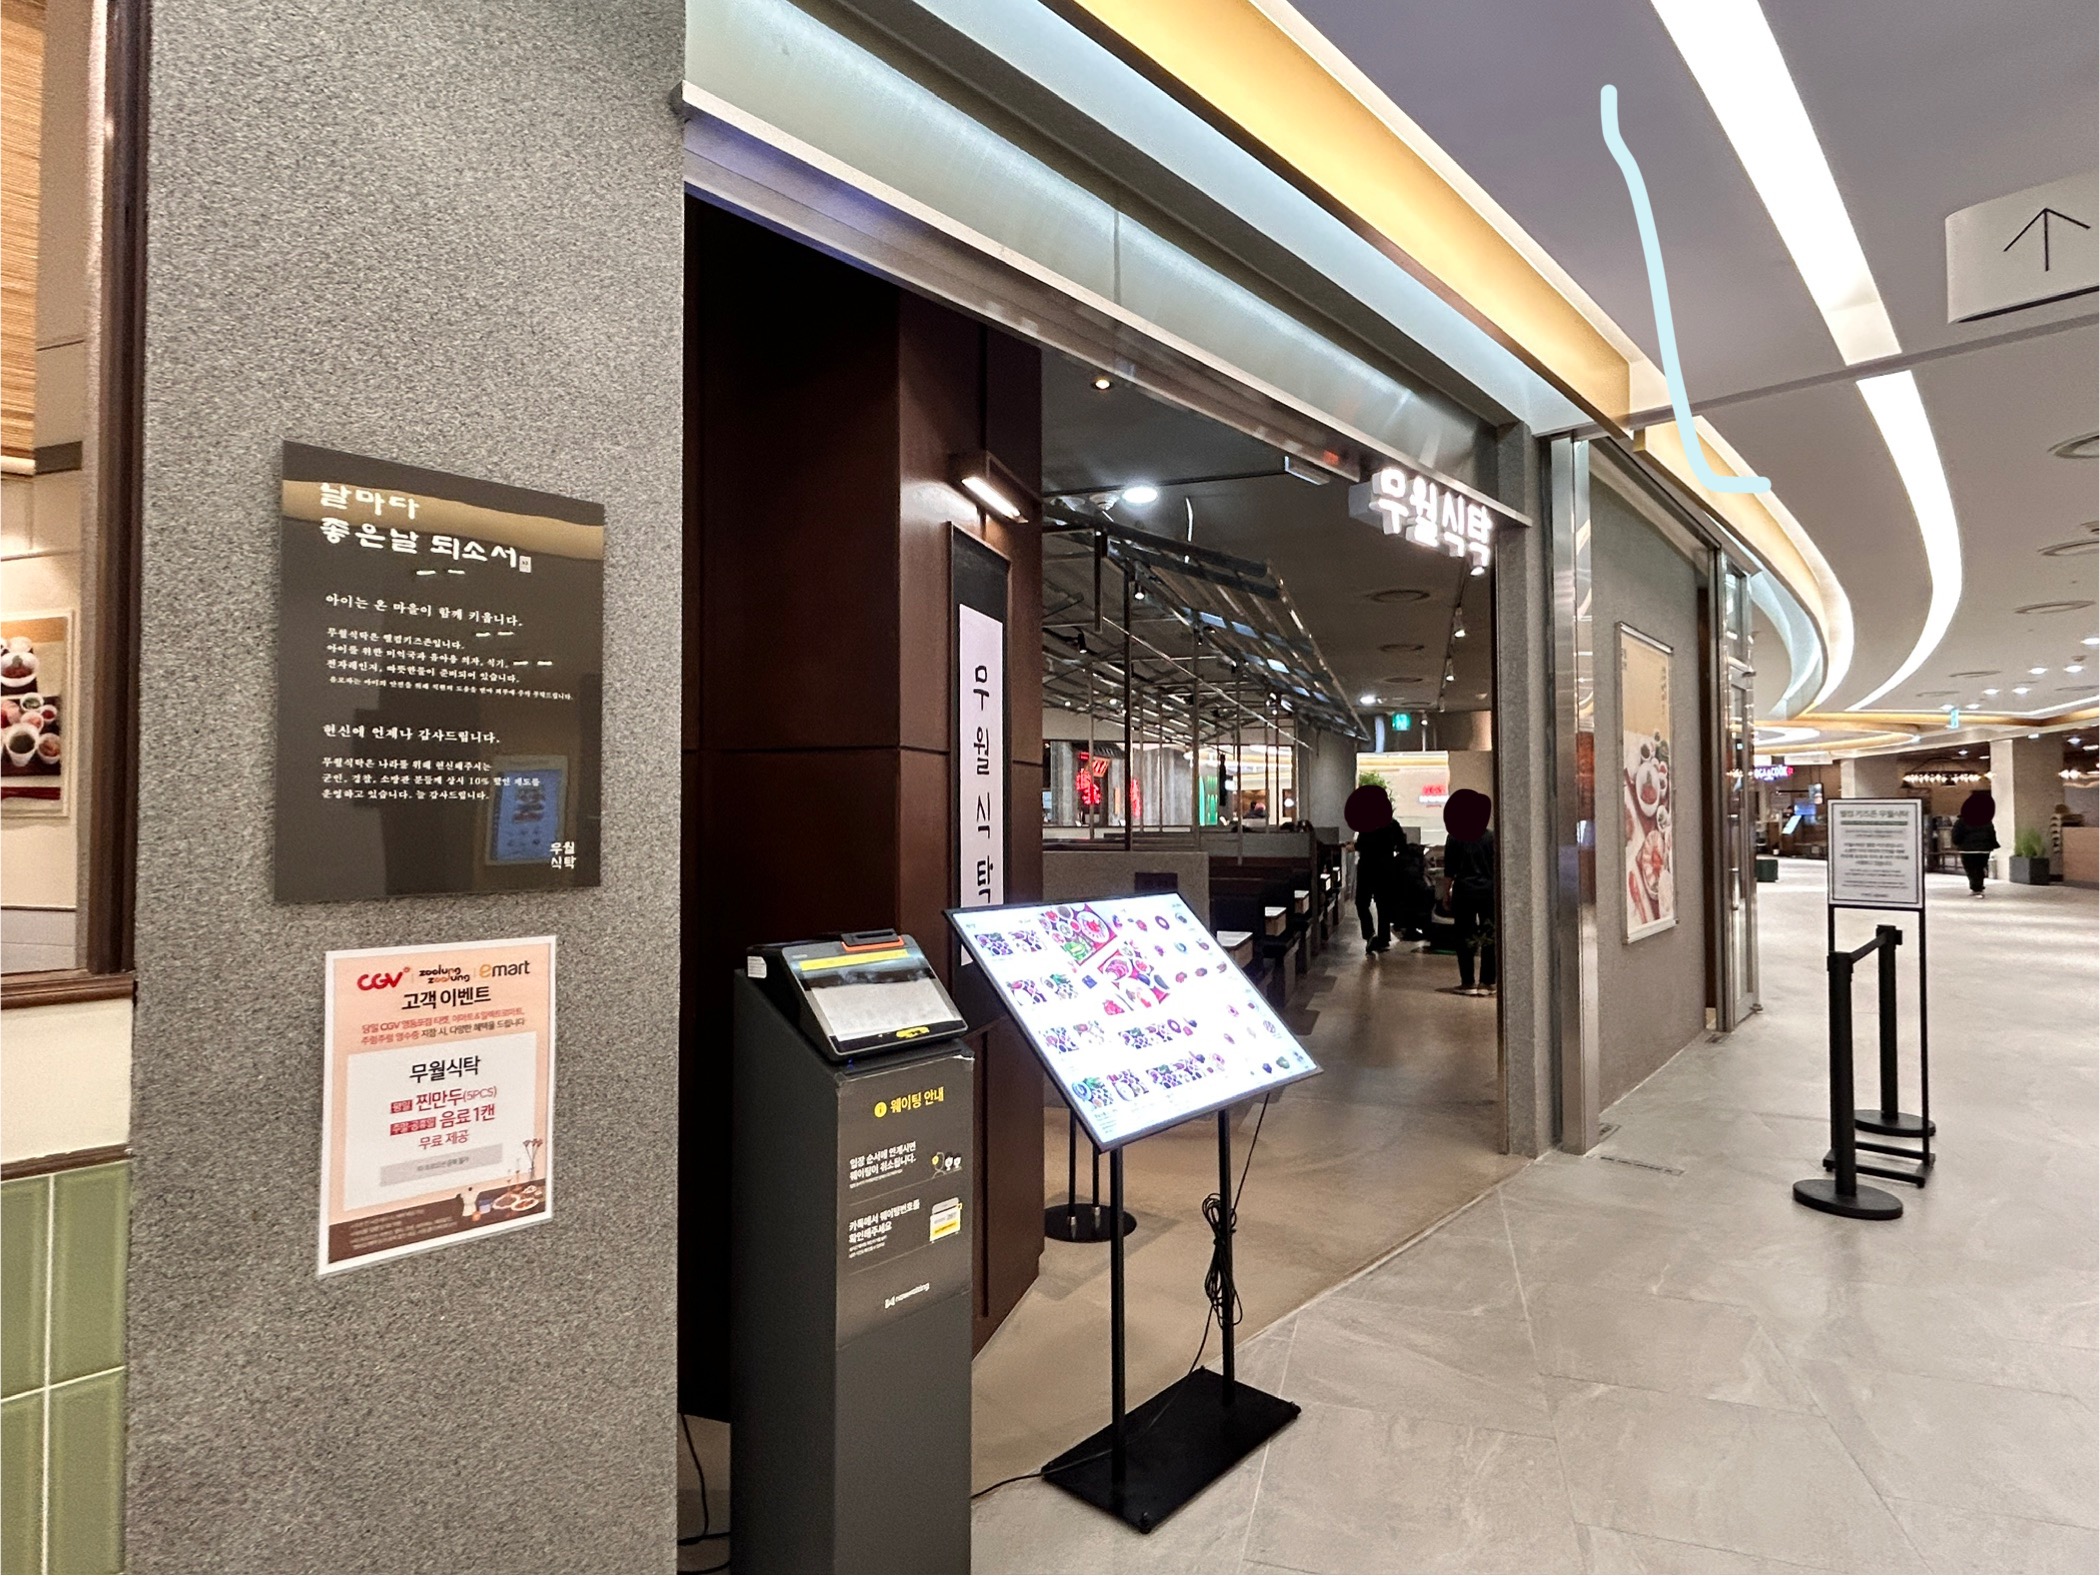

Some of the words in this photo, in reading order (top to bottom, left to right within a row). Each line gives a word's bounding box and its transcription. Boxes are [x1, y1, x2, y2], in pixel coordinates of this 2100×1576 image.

[320, 482, 419, 519] 날마다
[1373, 466, 1493, 567] 무월식탁
[320, 517, 418, 554] 좋은날
[430, 535, 517, 568] 되소서
[326, 593, 369, 609] 아이는
[374, 599, 388, 611] 온
[393, 601, 431, 617] 마을이
[439, 607, 463, 620] 함께
[469, 611, 523, 626] 키웁니다.
[327, 627, 380, 641] 무월식탁은
[326, 643, 358, 655] 아이를
[362, 647, 382, 657] 위한
[386, 649, 426, 660] 미역국과
[430, 653, 458, 664] 유아용
[440, 668, 476, 679] 준비되어
[480, 672, 520, 683] 있습니다.
[323, 723, 365, 738] 헌신에
[372, 726, 413, 740] 언제나
[418, 728, 500, 744] 감사드립니다.
[322, 757, 375, 769] 무월식탁은
[378, 759, 408, 770] 나라를
[412, 759, 431, 770] 위해
[435, 761, 492, 771] 헌신해주시는
[381, 775, 410, 785] 소방관
[446, 776, 464, 785] 상시
[469, 777, 490, 785] 10%
[973, 665, 994, 904] 무월식탁
[322, 788, 365, 799] 운영하고
[368, 789, 413, 800] 있습니다.
[416, 790, 426, 800] 늘
[429, 790, 489, 800] 감사드립니다.
[550, 841, 575, 855] 무월
[551, 856, 577, 869] 식탁
[479, 960, 531, 978] emart
[357, 970, 404, 991] CGV
[401, 989, 437, 1011] 고객
[440, 986, 492, 1008] 이벤트
[380, 1021, 401, 1031] CGV
[409, 1055, 482, 1083] 무월식탁
[890, 1092, 921, 1113] 웨이팅
[924, 1086, 944, 1105] 안내
[418, 1135, 443, 1150] 무료
[445, 1129, 469, 1144] 제공
[849, 1156, 865, 1169] 입장
[849, 1164, 879, 1181] 웨이팅이
